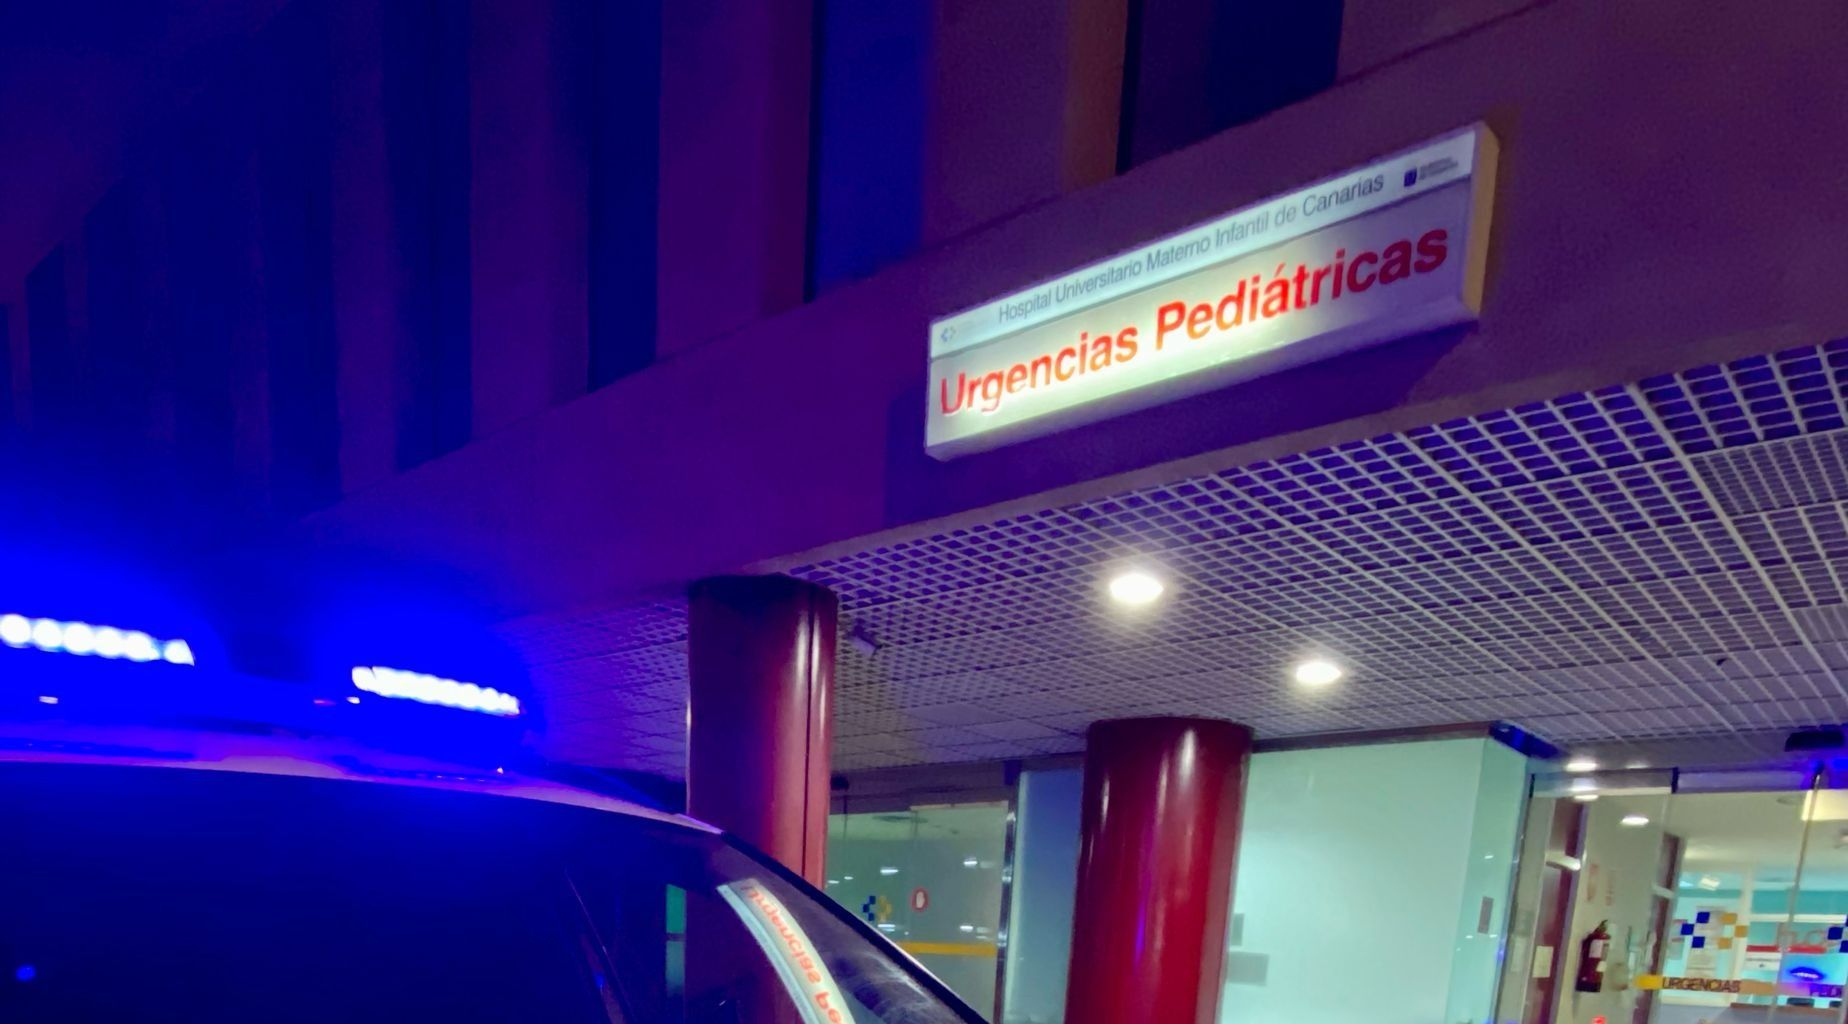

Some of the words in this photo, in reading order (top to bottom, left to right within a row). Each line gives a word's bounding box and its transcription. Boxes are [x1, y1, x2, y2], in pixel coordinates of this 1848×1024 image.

[940, 326, 1138, 414] Urgencias
[1155, 228, 1448, 350] Pediátricas
[999, 289, 1051, 323] Hospital
[1056, 262, 1142, 303] Universitario
[1146, 236, 1211, 272] Materno
[1216, 213, 1269, 247] Infantil
[1274, 204, 1297, 227] de
[1303, 174, 1384, 216] Canarias
[1662, 977, 1741, 993] URGENCIAS
